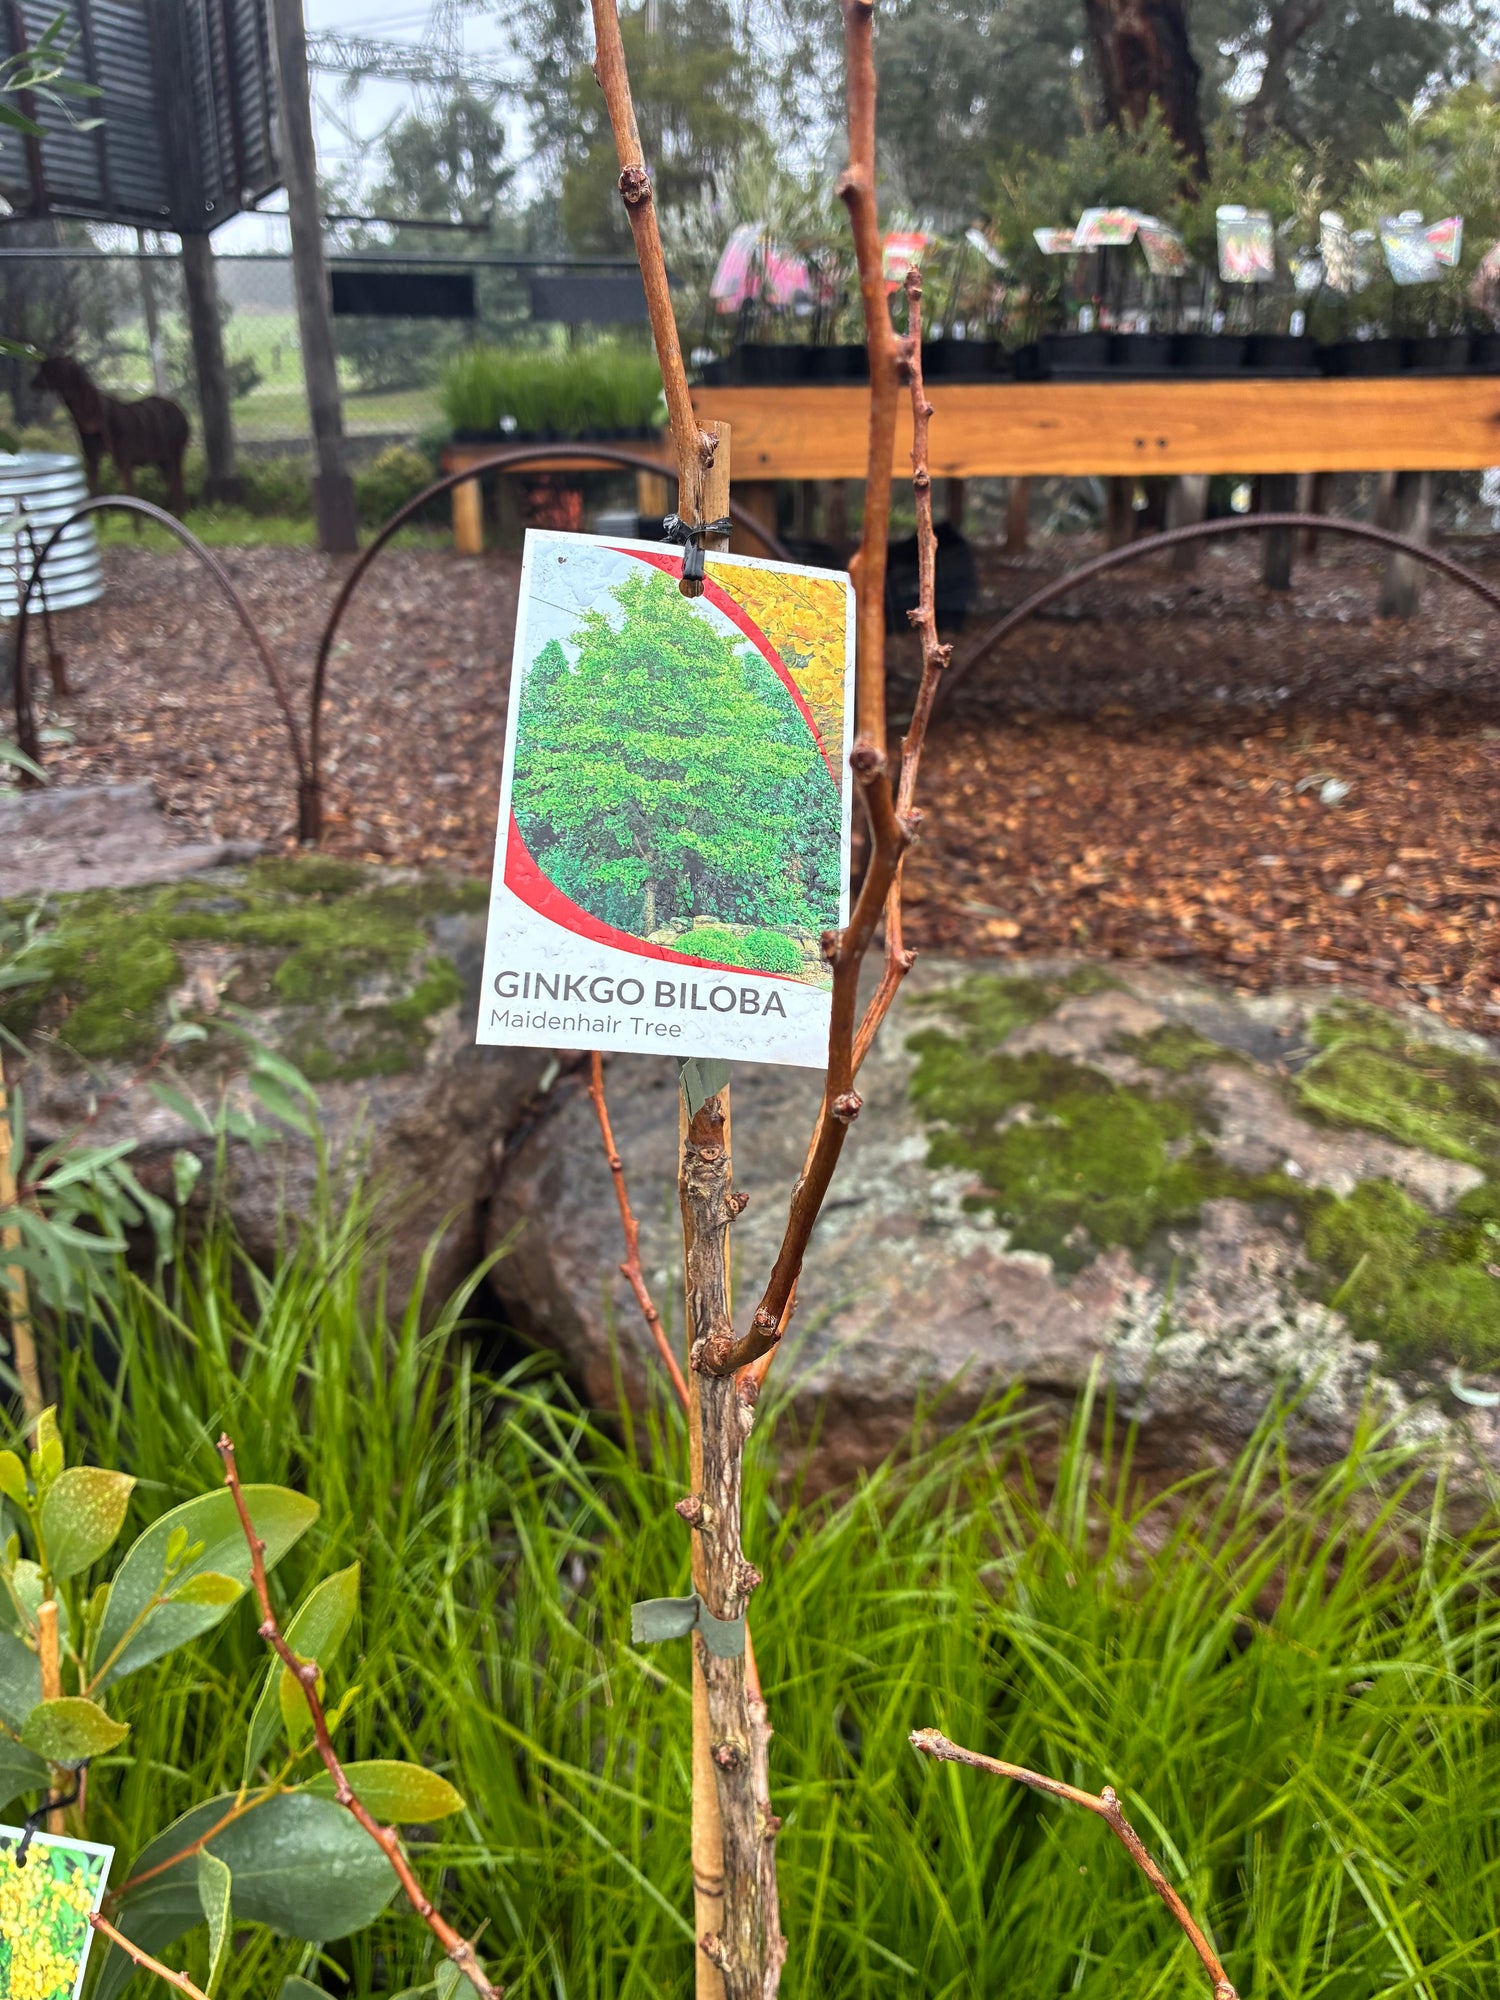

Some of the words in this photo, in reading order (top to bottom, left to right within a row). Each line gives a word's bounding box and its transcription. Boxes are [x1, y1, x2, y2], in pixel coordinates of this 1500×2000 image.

[493, 970, 645, 1005] GINKGO
[654, 980, 787, 1018] BILOBA
[490, 1009, 622, 1034] Maidenhair
[629, 1017, 682, 1037] Tree
